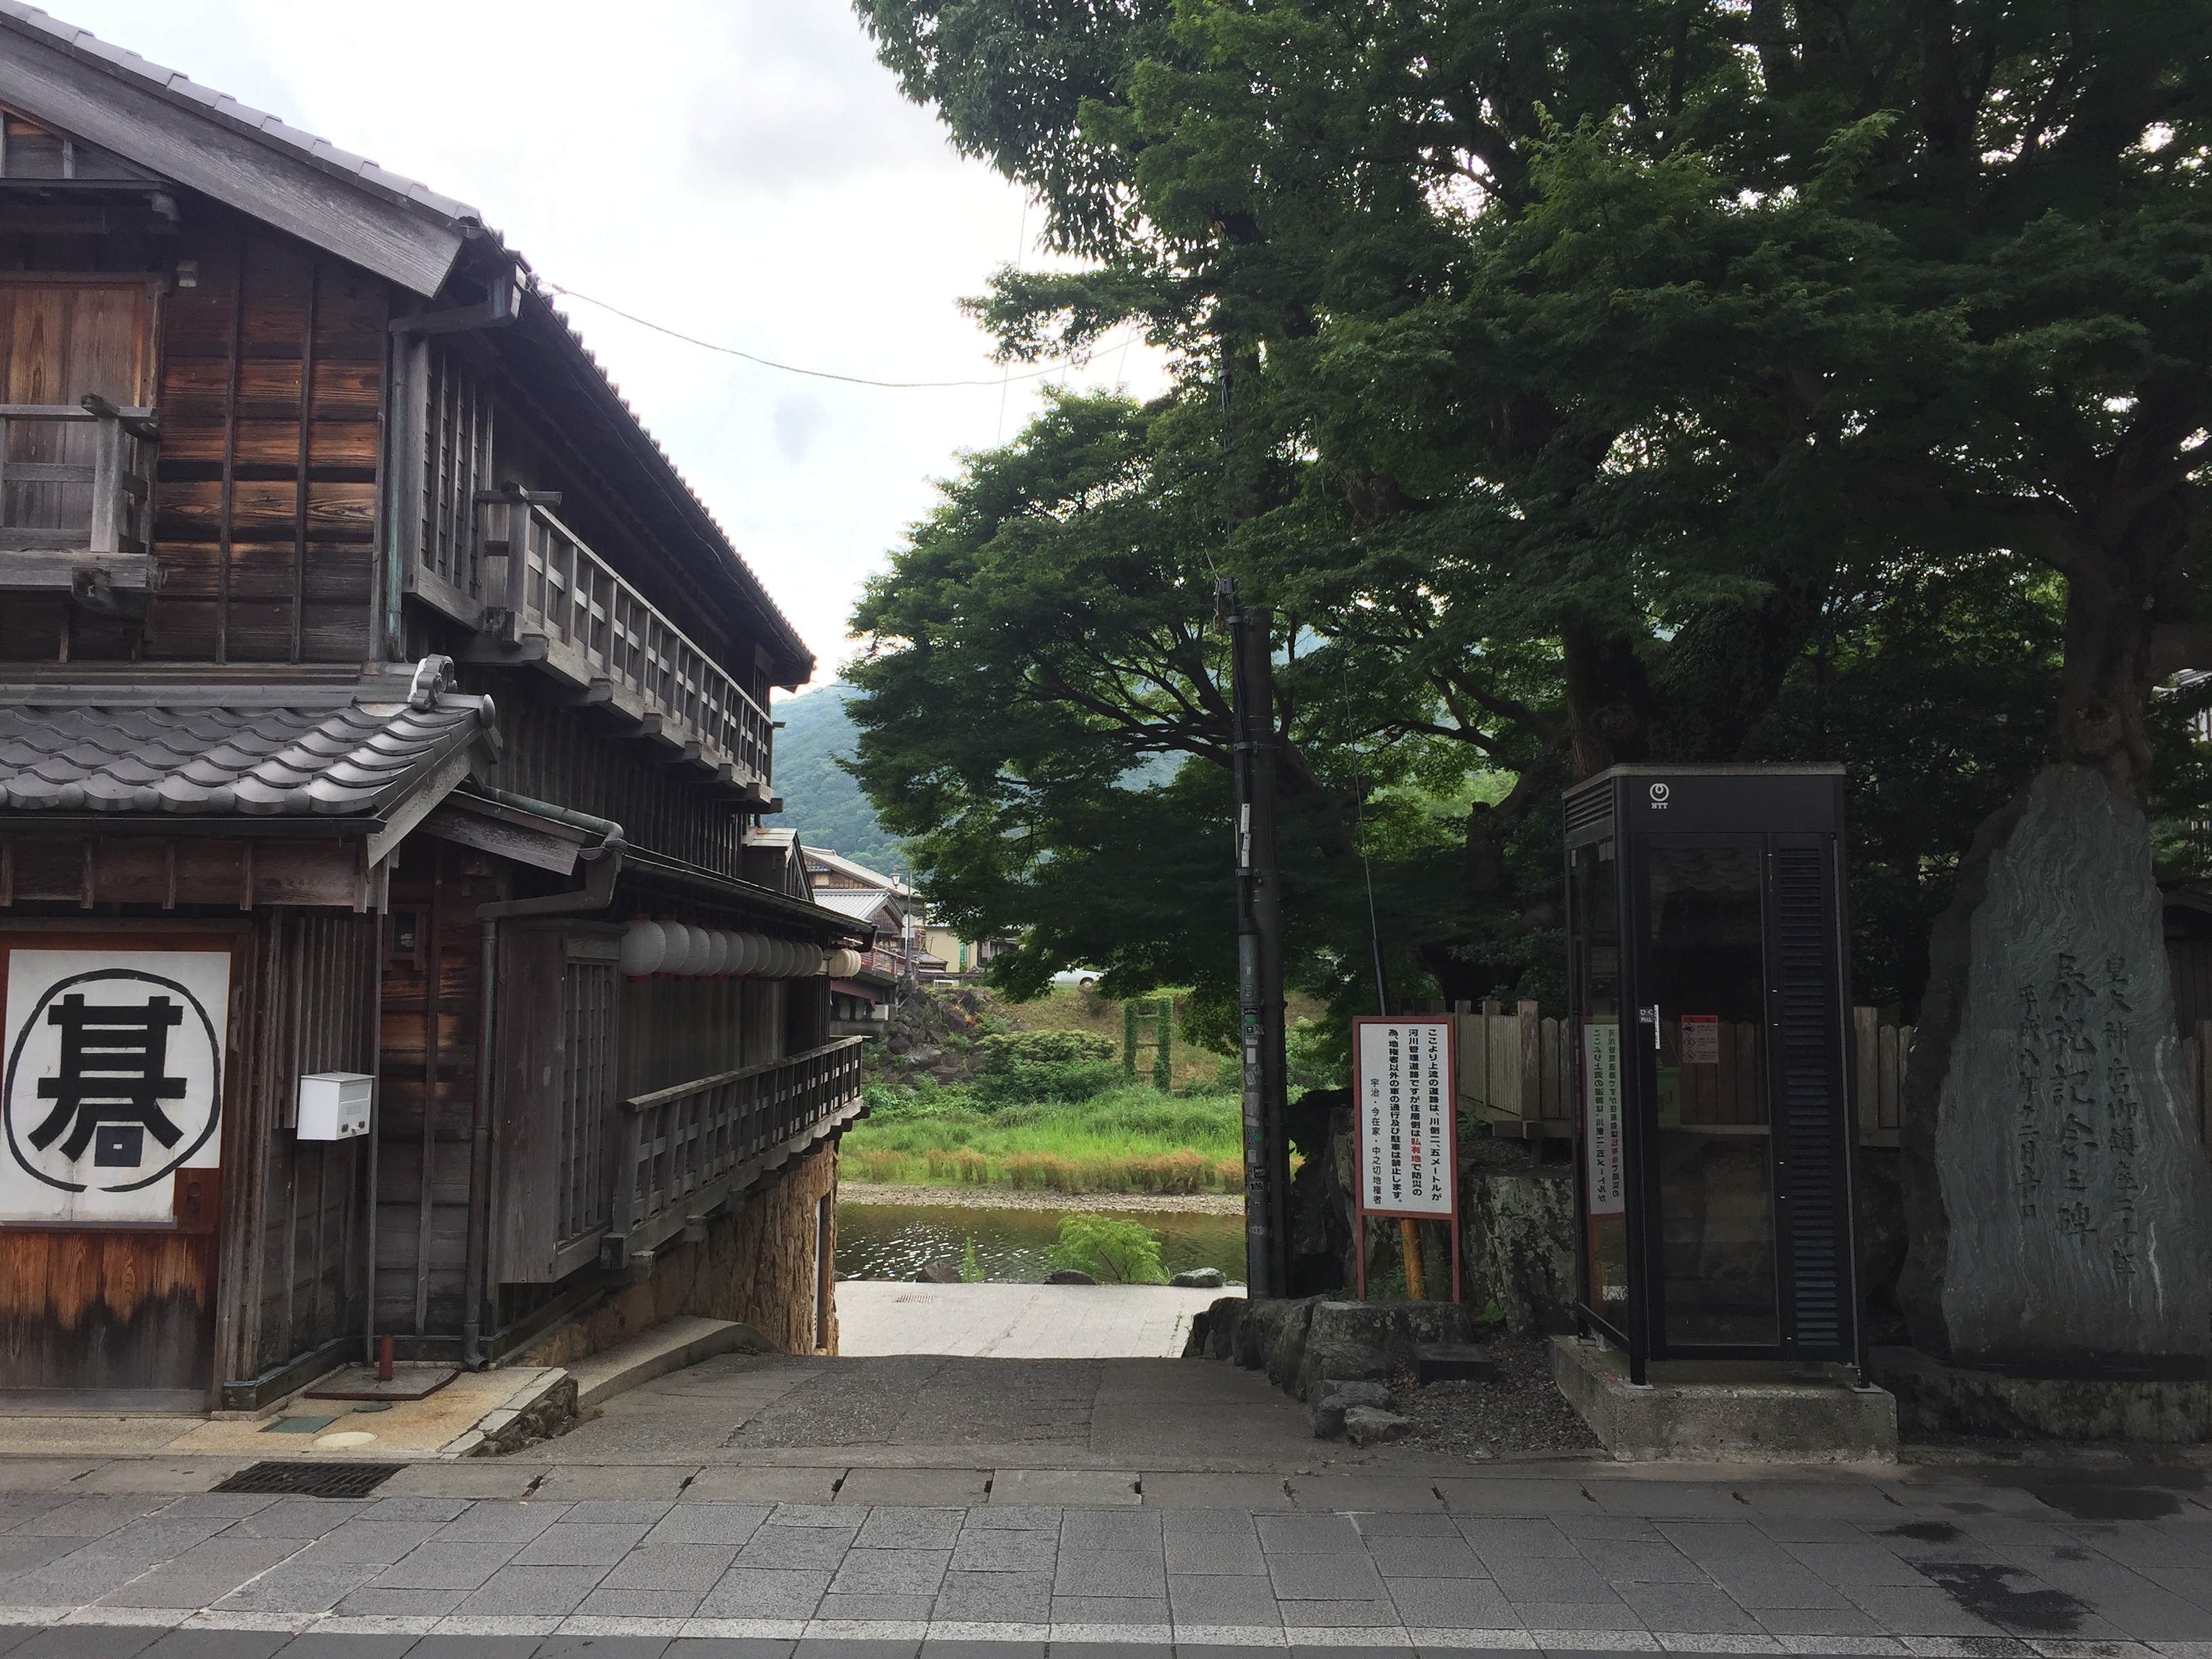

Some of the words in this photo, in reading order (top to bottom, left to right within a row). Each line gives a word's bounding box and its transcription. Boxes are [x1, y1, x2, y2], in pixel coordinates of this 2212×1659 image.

[1408, 1029, 1422, 1196] 河川管理道路ですが住居側は私有地で防災の
